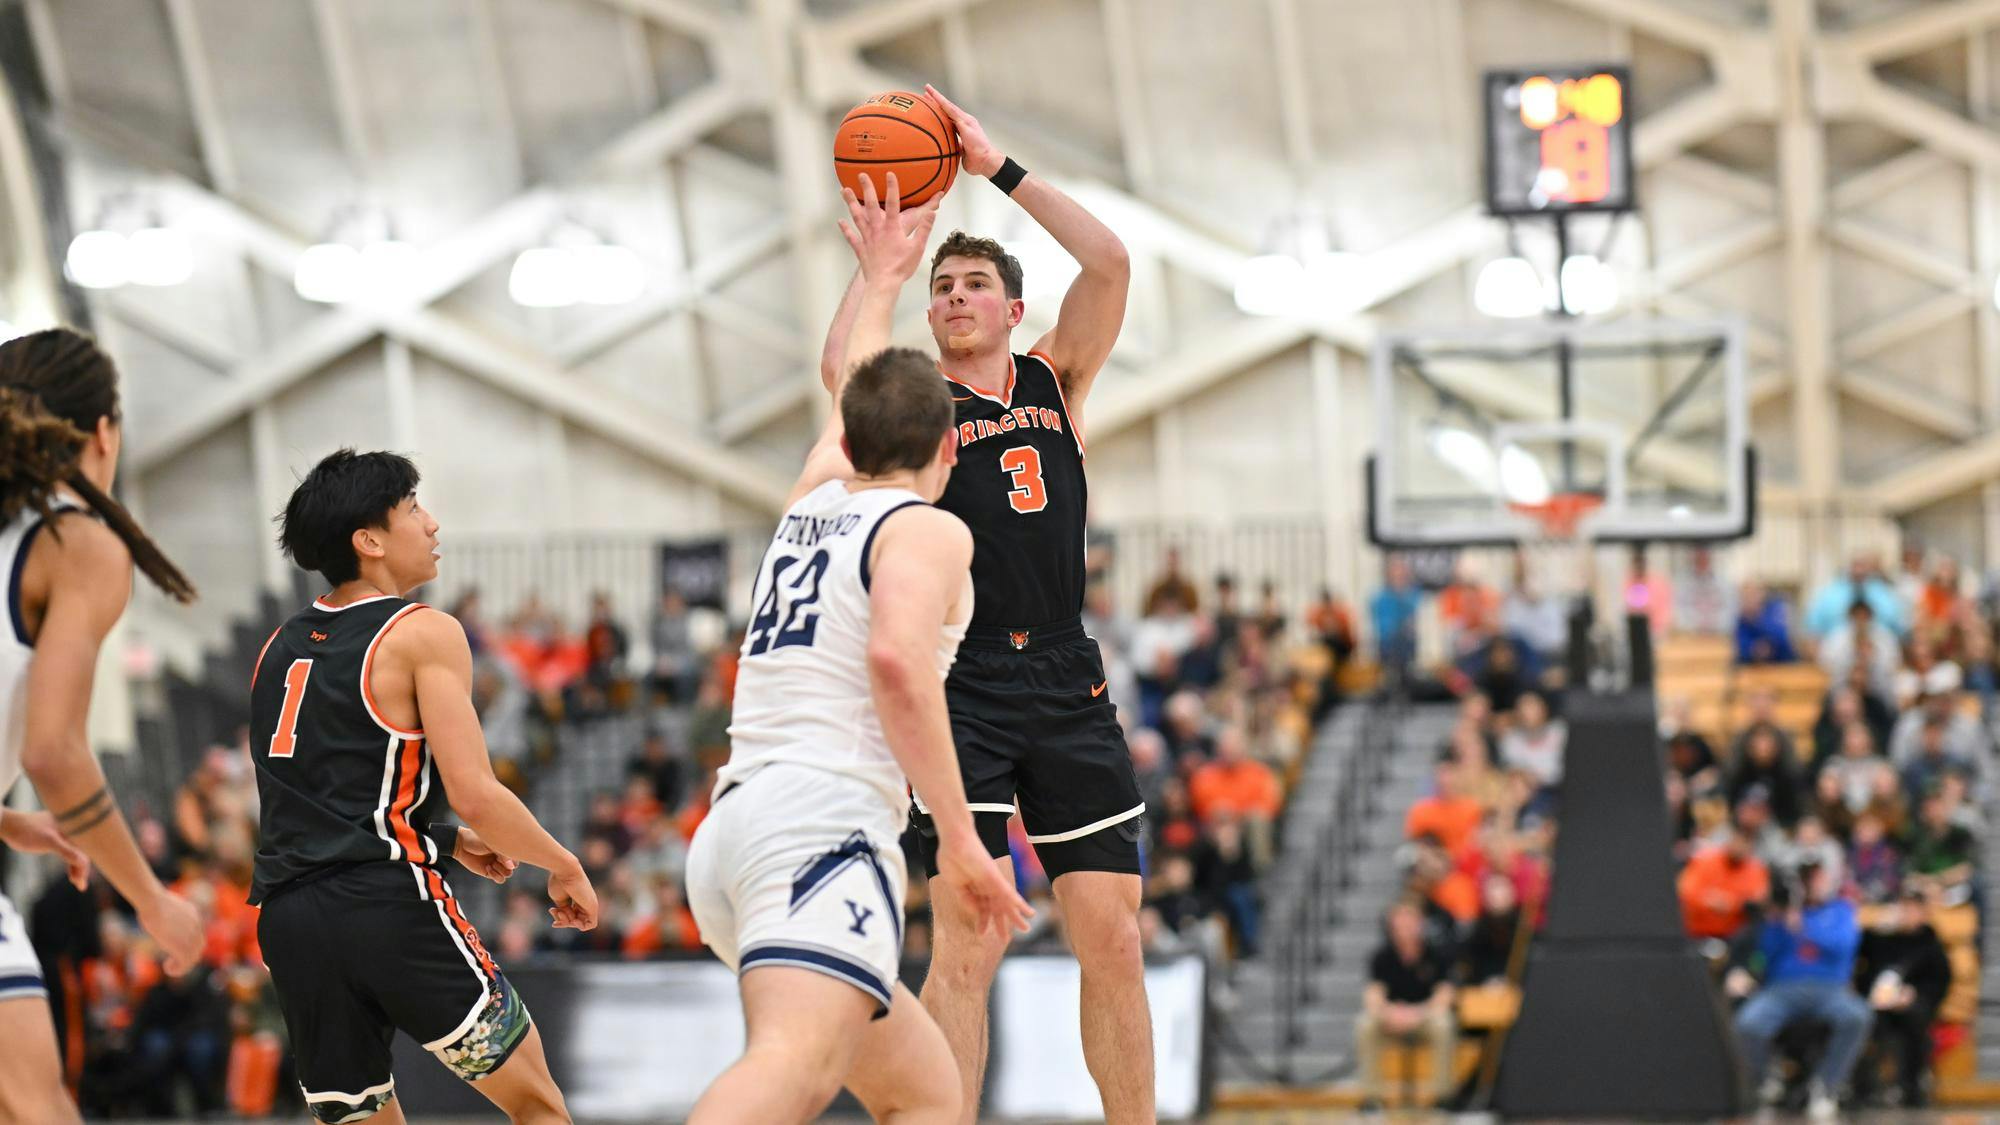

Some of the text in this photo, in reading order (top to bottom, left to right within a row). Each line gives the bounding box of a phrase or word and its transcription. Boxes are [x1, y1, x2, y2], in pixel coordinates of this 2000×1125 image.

[957, 406, 1062, 447] RINCETON
[1000, 445, 1048, 514] 3
[777, 513, 861, 546] TOWNEND
[748, 549, 829, 656] 42
[269, 659, 313, 757] 1
[844, 898, 873, 936] Y
